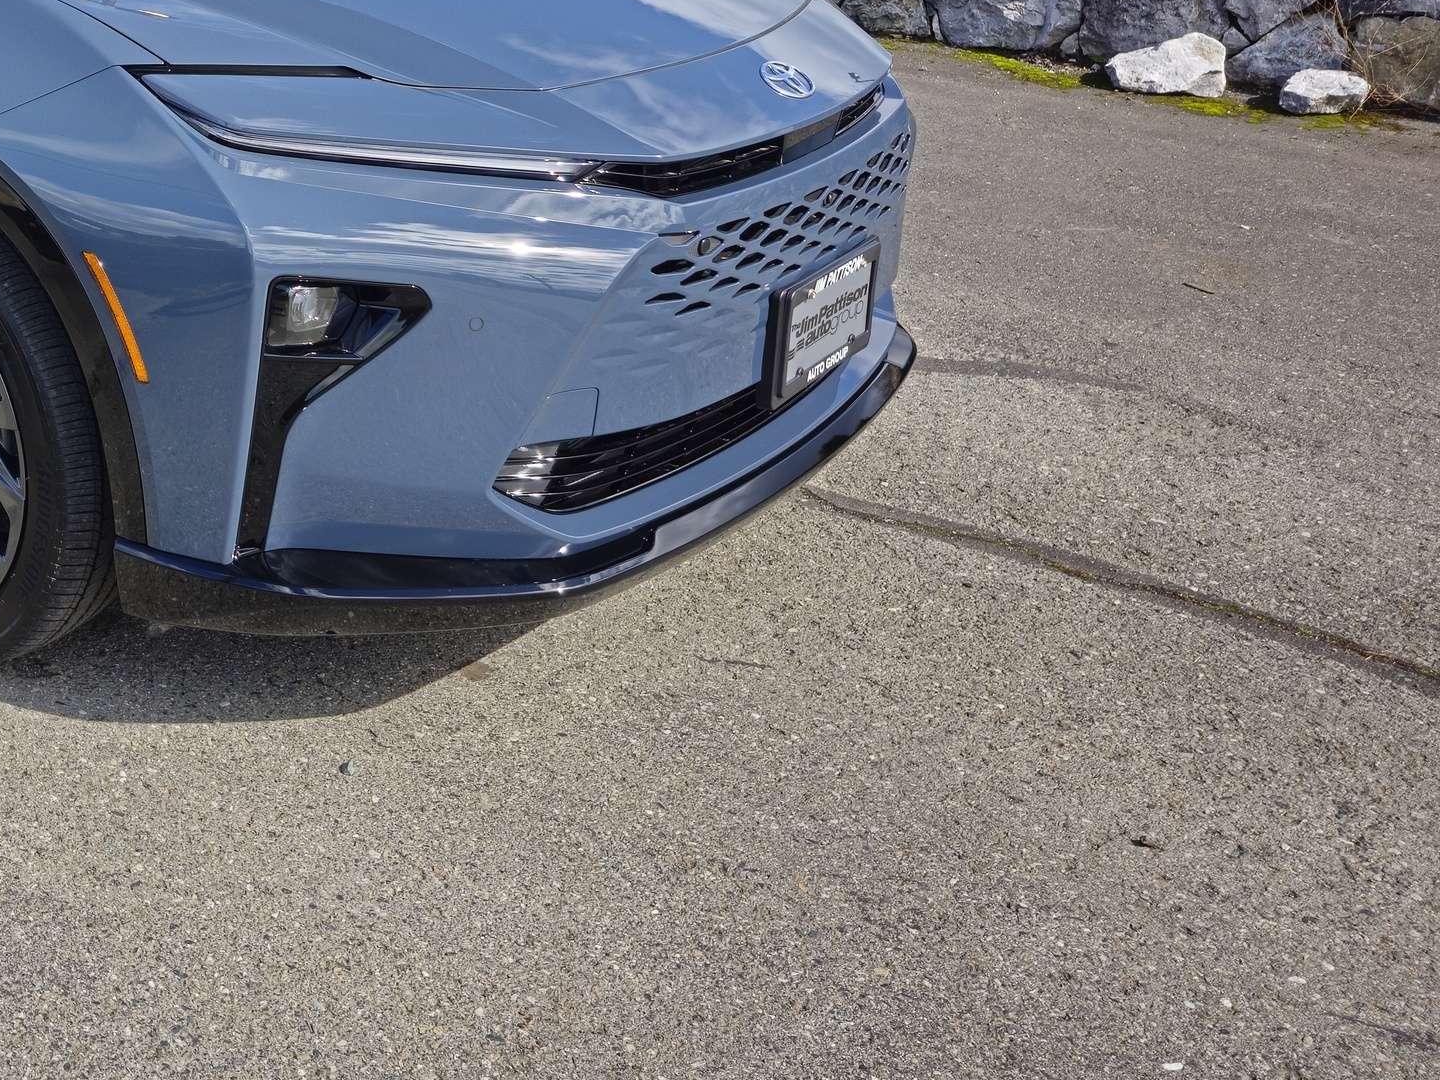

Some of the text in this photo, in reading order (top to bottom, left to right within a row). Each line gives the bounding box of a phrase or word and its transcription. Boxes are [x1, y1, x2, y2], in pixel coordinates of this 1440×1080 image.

[796, 313, 819, 338] Jim
[818, 284, 869, 324] Pattison
[807, 345, 849, 382] AUTO GROUP
